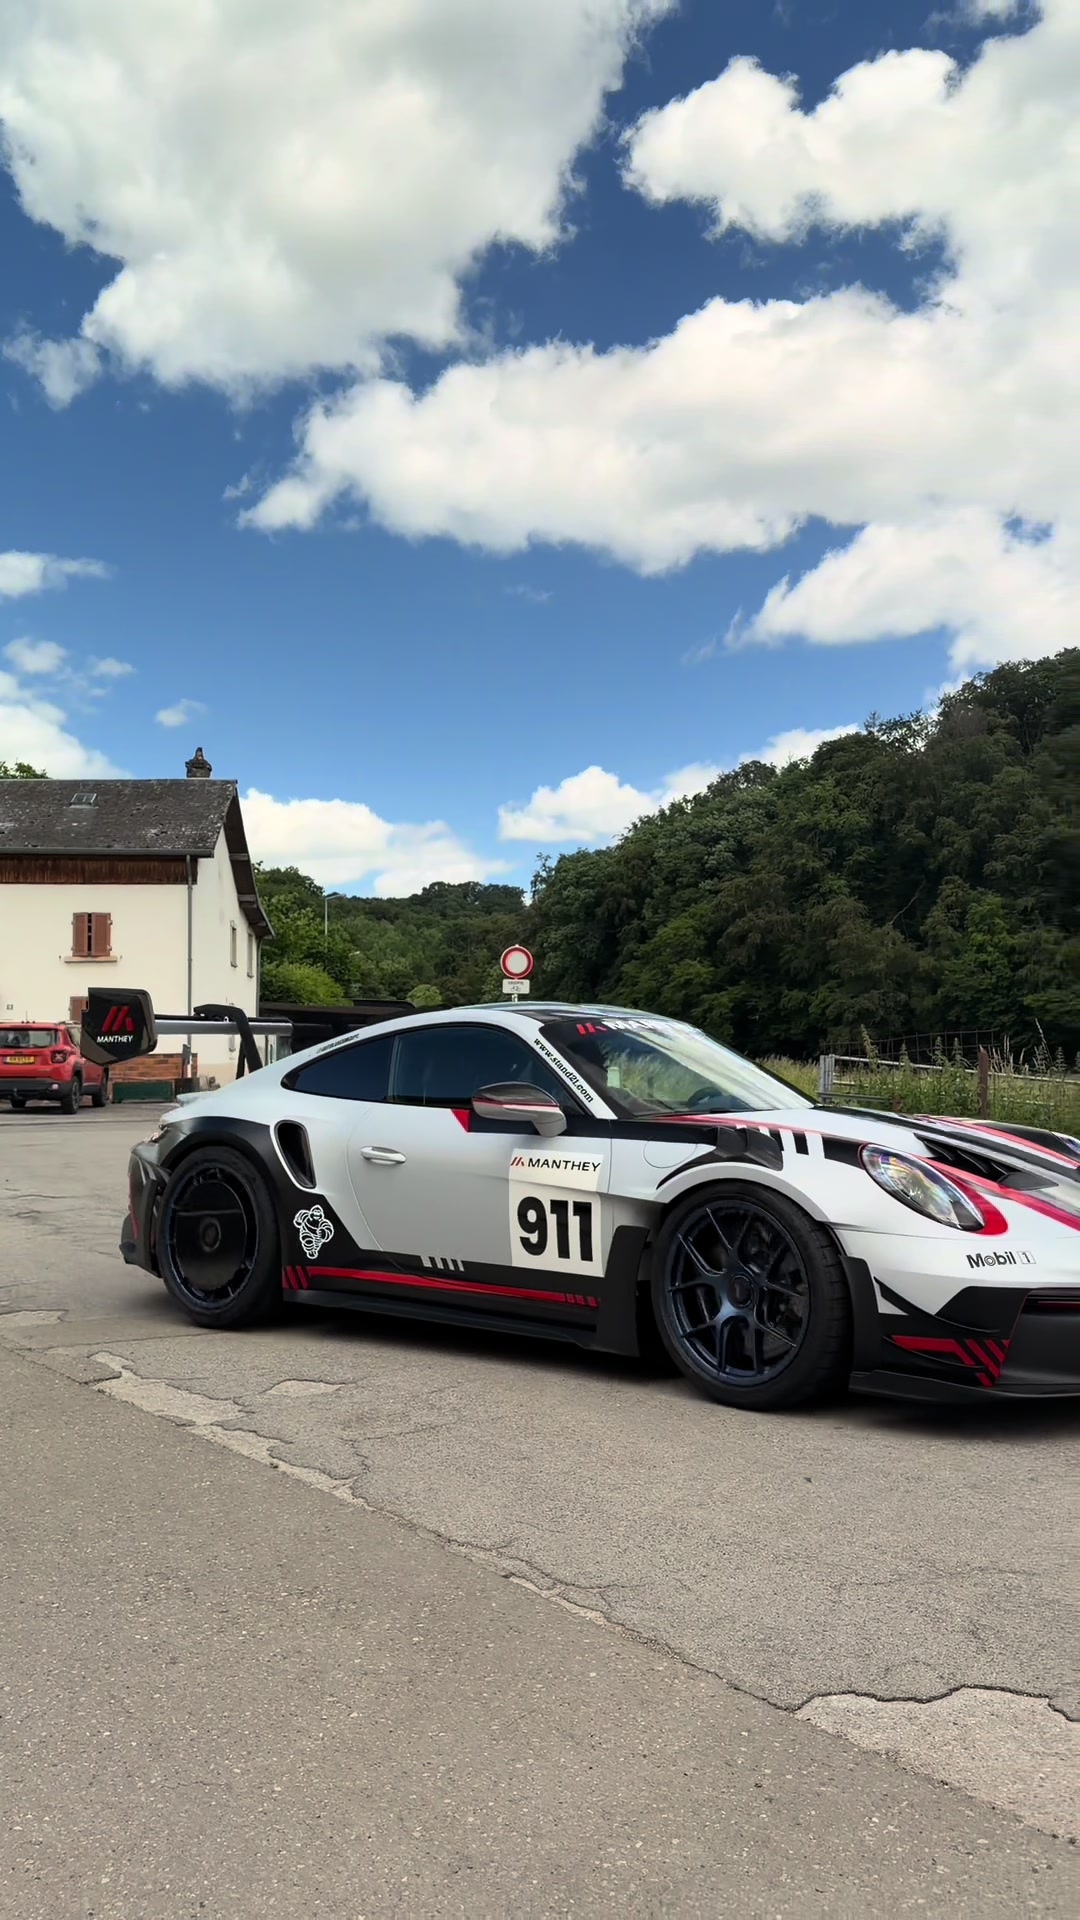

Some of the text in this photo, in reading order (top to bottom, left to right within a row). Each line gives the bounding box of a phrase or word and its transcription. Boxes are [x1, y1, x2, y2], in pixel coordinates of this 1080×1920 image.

[97, 1035, 133, 1043] MANTHEY
[534, 1038, 594, 1103] www.stand21.com
[528, 1158, 601, 1172] MANTHEY
[517, 1196, 593, 1262] 911
[966, 1251, 1017, 1269] Mobil
